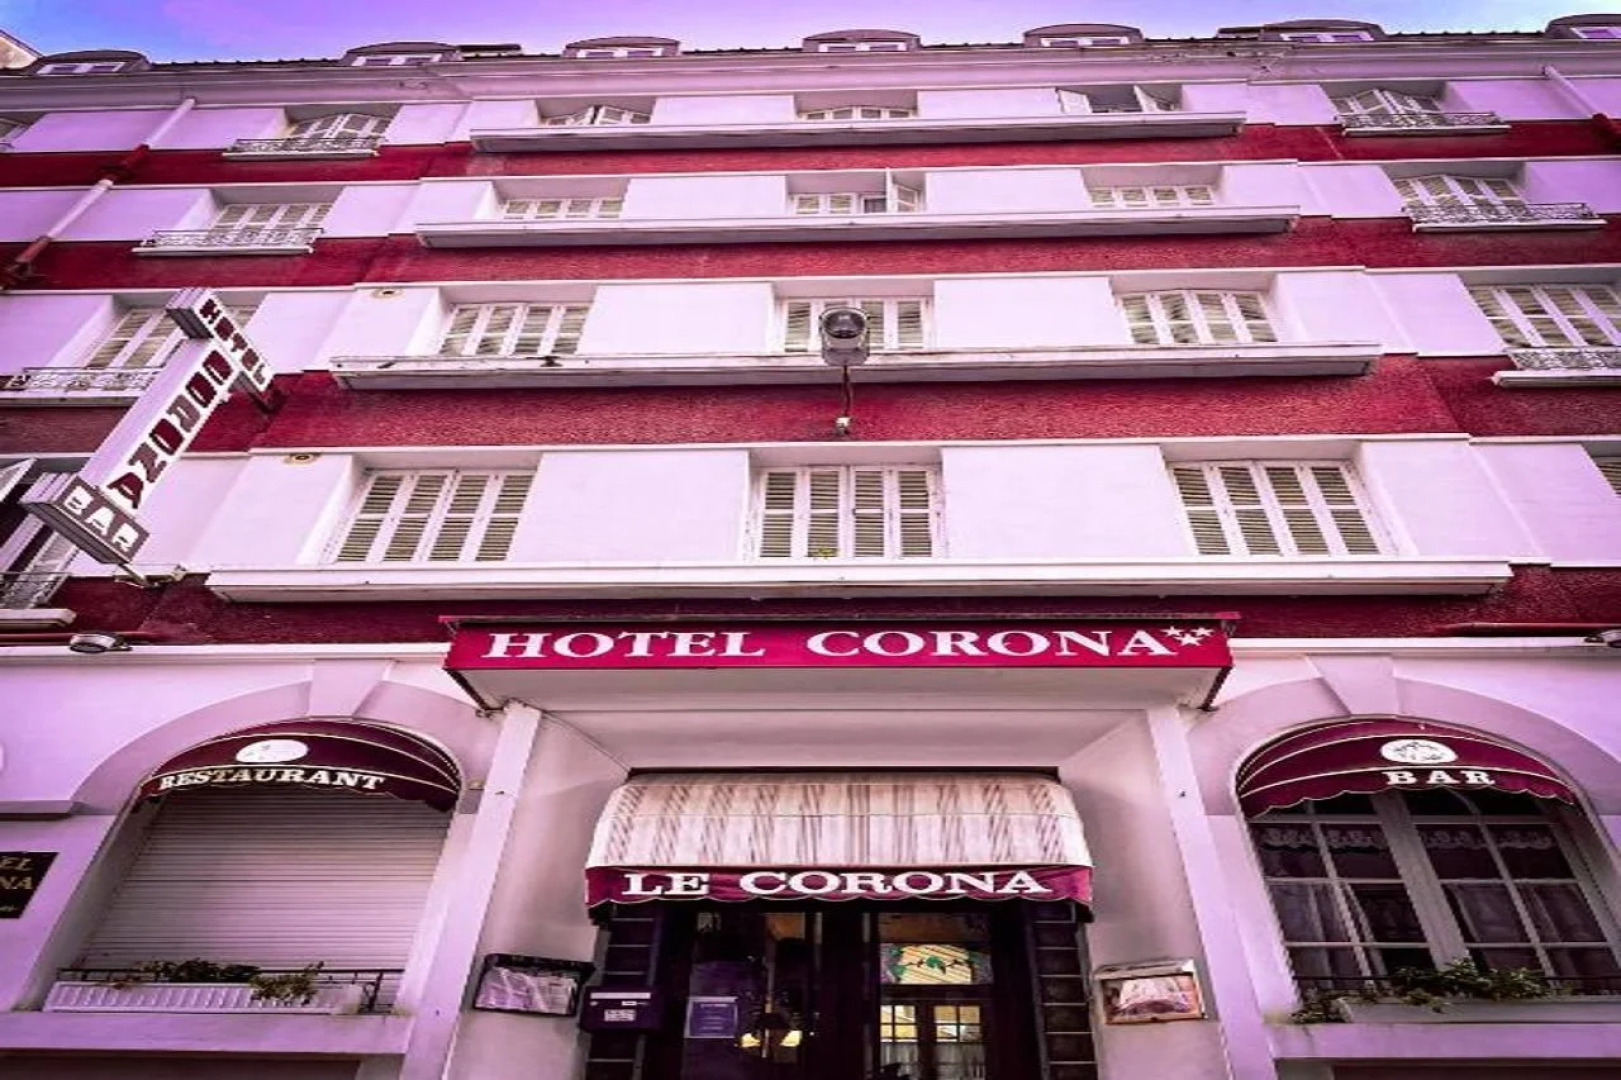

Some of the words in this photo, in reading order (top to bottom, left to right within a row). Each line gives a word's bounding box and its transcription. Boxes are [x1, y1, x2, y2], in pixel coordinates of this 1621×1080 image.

[199, 299, 266, 384] HOTEL
[106, 350, 234, 509] CORONA
[65, 486, 141, 552] BAR
[481, 631, 765, 659] HOTEL
[806, 630, 1178, 658] CORONA
[158, 767, 386, 791] RESTAURANT
[1383, 771, 1495, 785] BAR
[622, 873, 710, 896] LE
[739, 871, 1053, 896] CORONA
